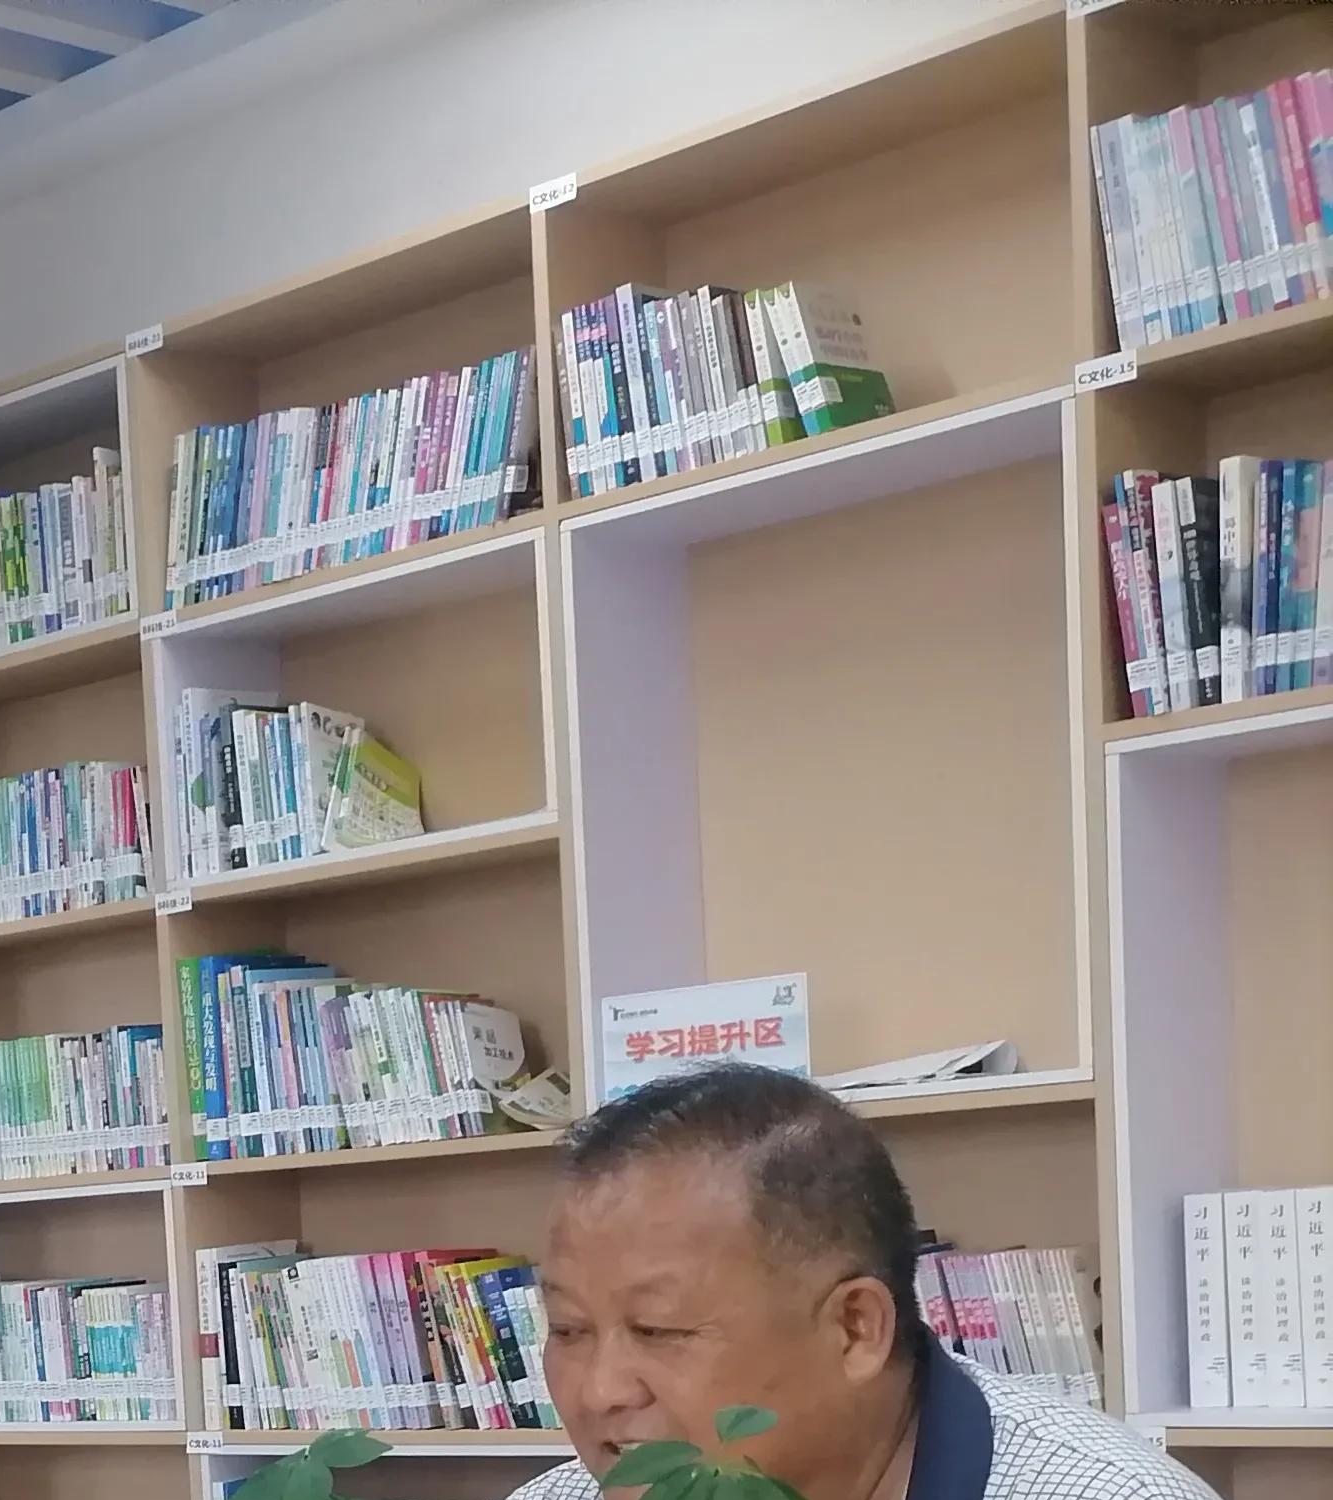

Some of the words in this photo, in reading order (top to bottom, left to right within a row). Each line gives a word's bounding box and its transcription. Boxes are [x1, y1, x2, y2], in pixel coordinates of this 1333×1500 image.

[1077, 361, 1135, 384] C文化-15
[625, 1016, 786, 1063] 学习提升区
